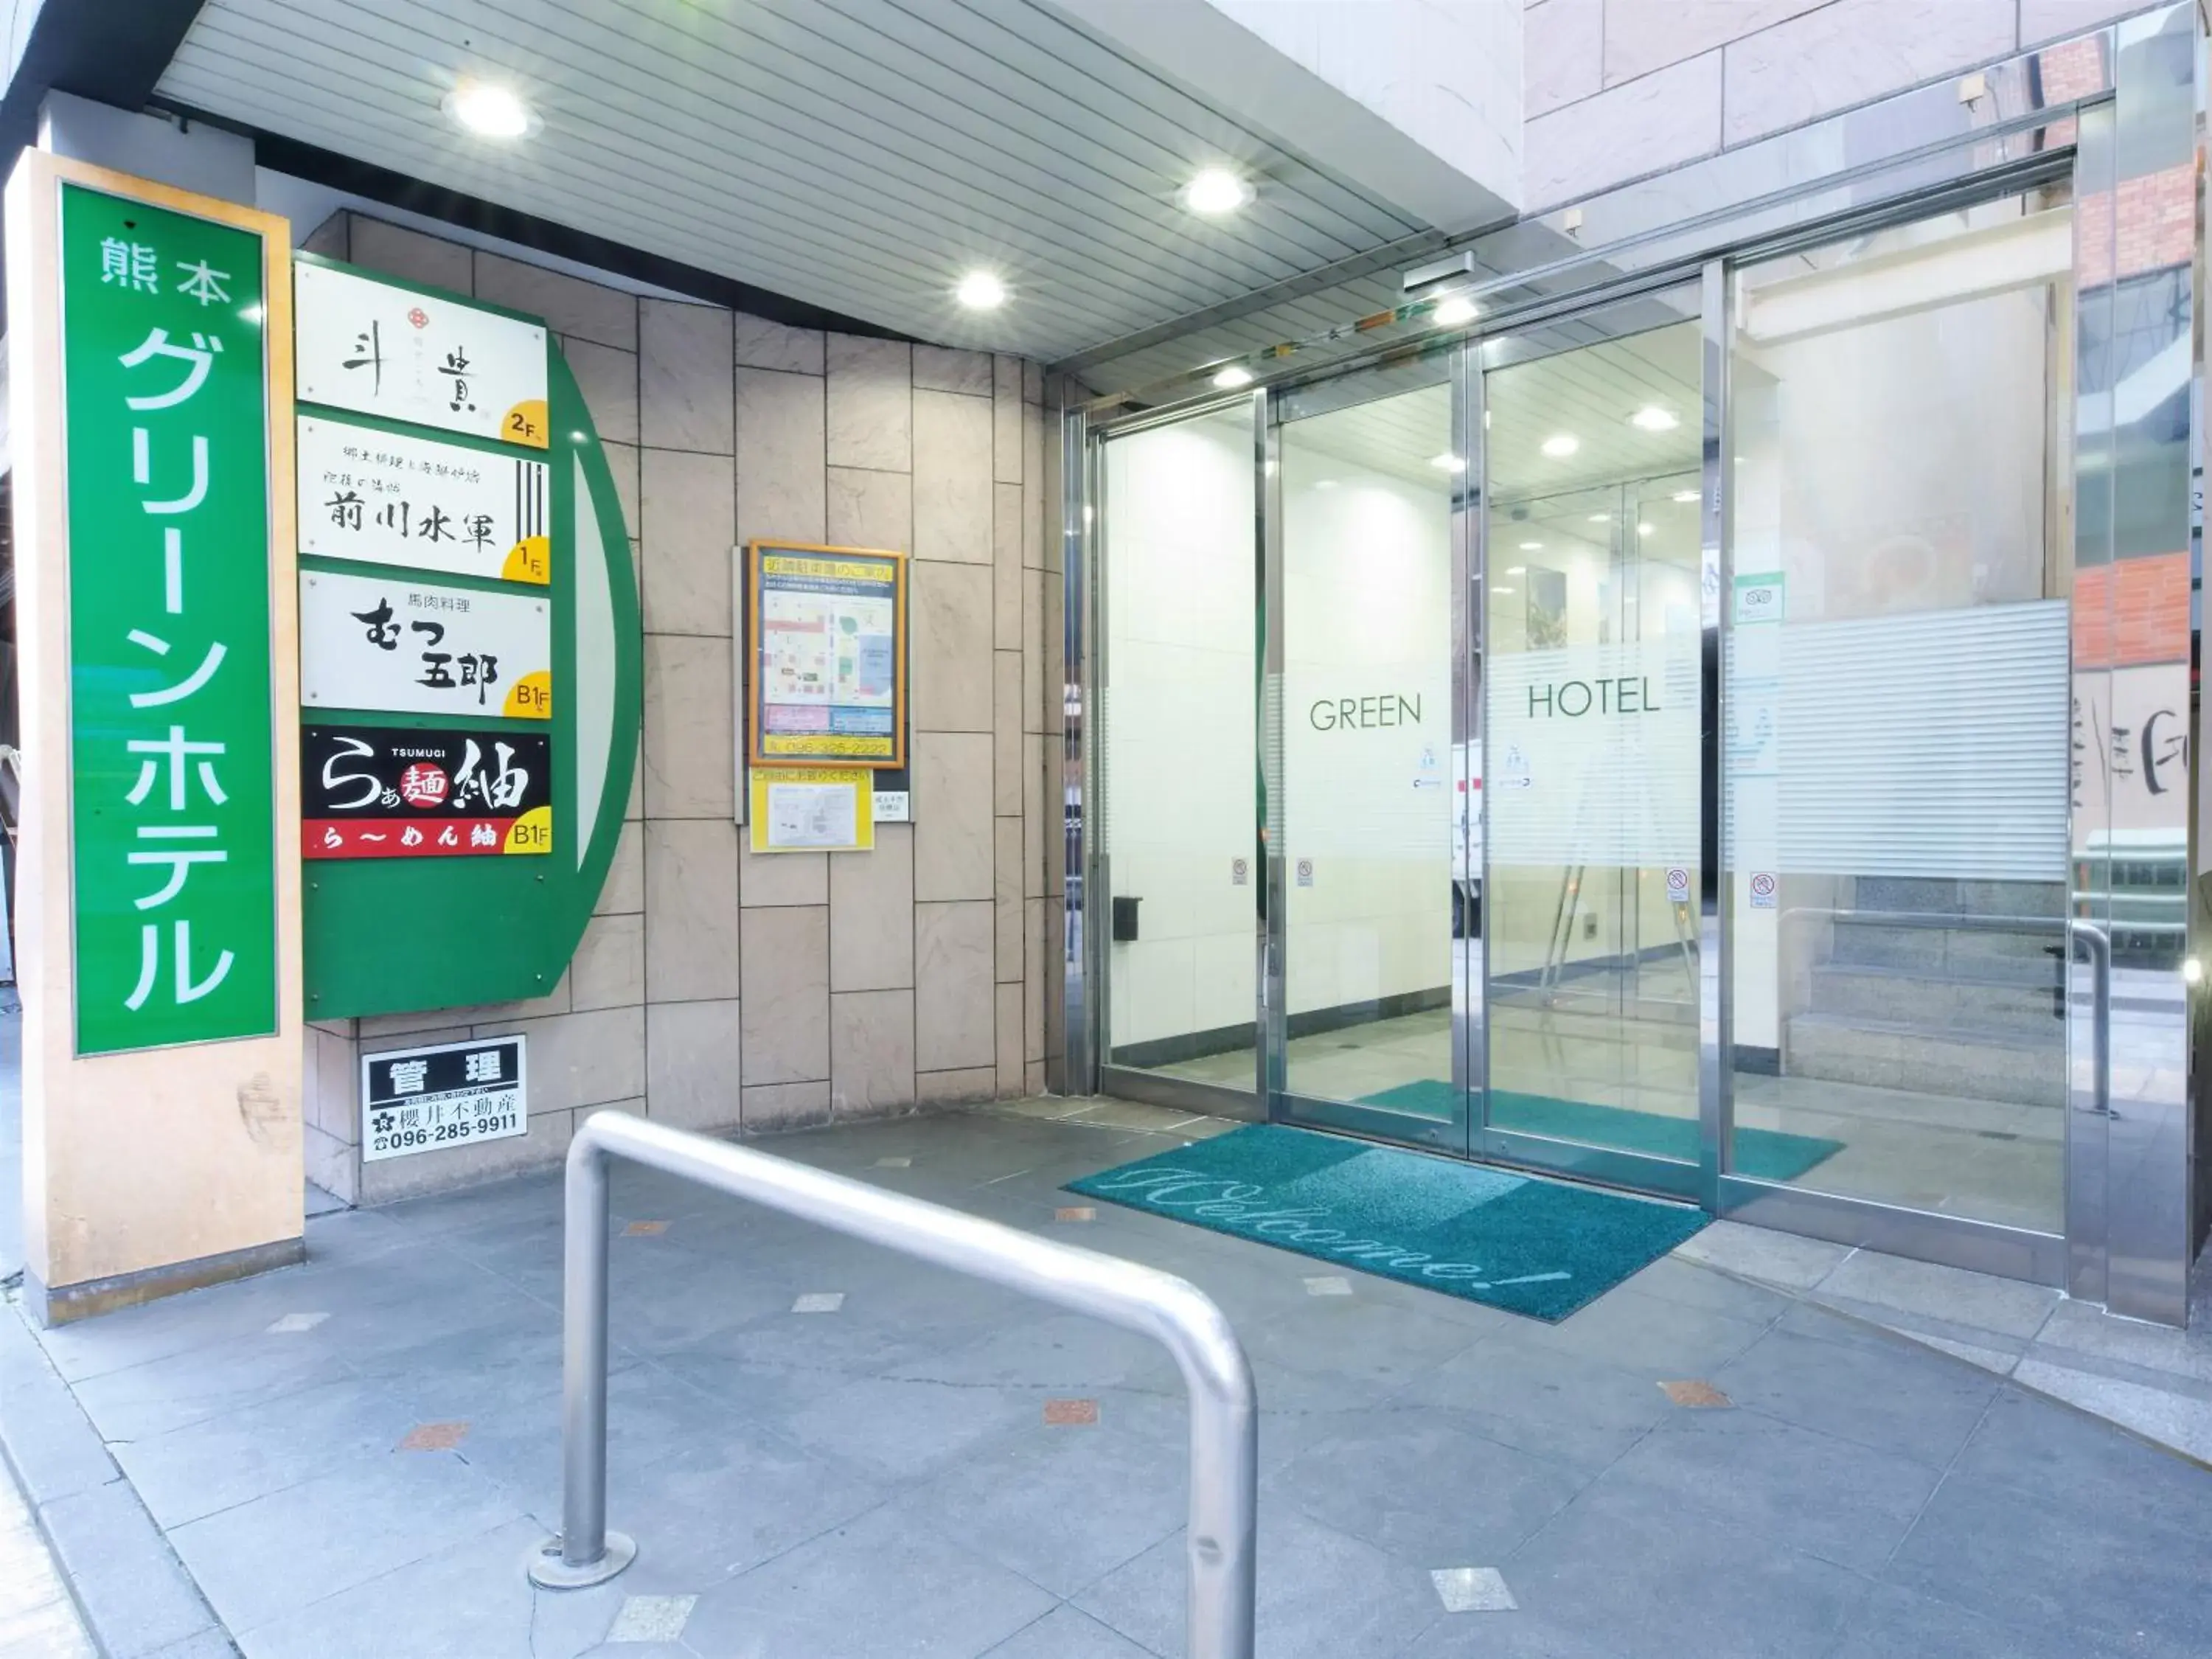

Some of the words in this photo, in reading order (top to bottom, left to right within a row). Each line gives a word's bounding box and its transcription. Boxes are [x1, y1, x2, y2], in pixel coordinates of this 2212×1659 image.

[100, 237, 232, 306] 熊本
[511, 412, 535, 438] 2F
[324, 490, 496, 554] 前川水軍
[407, 593, 471, 613] 馬肉料理
[119, 327, 235, 1012] グリーンホテル
[517, 684, 549, 706] B1F
[1310, 693, 1422, 731] GREEN
[1528, 676, 1661, 719] HOTEL
[392, 748, 446, 759] TSUMUGI
[514, 824, 549, 846] B1F
[389, 1050, 502, 1095] 管理
[390, 1113, 517, 1150] 096-285-9911
